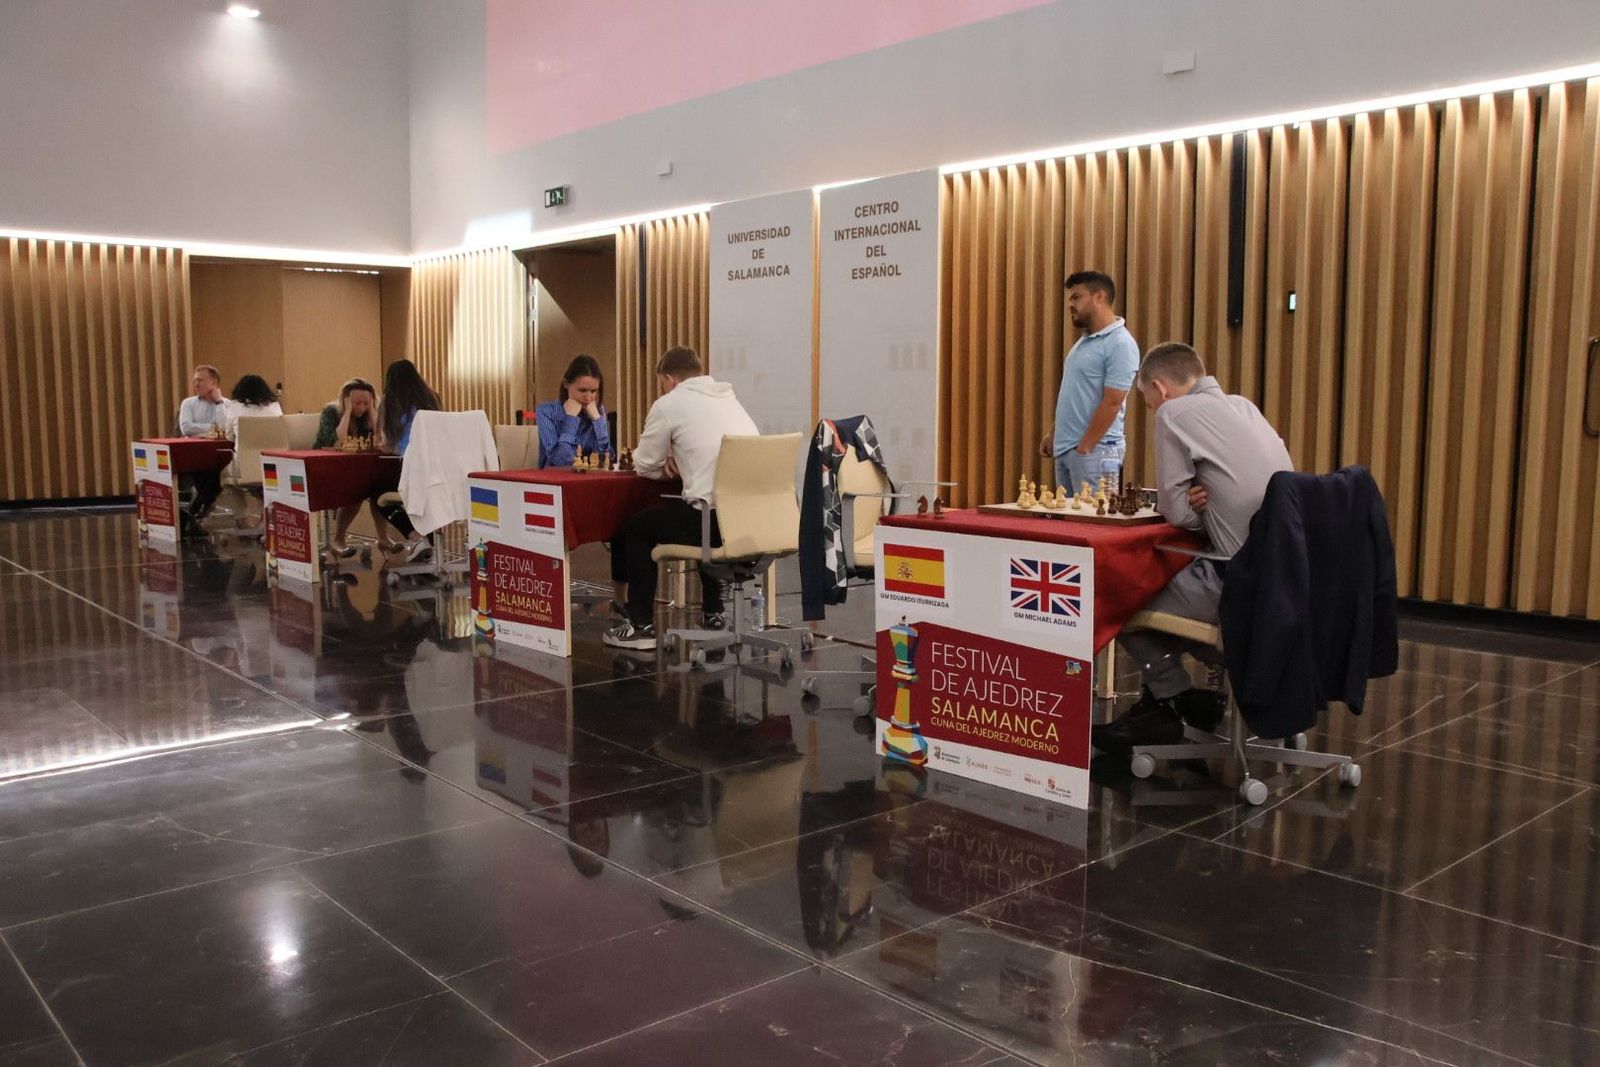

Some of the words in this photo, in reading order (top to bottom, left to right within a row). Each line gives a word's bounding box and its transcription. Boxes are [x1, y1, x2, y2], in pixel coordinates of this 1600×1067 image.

[854, 200, 899, 218] CENTRO
[727, 226, 791, 244] UNIVERSIDAD
[834, 219, 921, 242] INTERNACIONAL
[751, 248, 765, 260] DE
[866, 245, 887, 258] DEL
[727, 264, 791, 281] SALAMANCA
[851, 263, 902, 280] ESPAÑOL
[493, 553, 537, 576] FESTIVAL
[494, 572, 508, 590] DE
[509, 575, 553, 598] AJEDREZ
[495, 590, 552, 615] SALAMANCA
[880, 592, 890, 600] GM
[890, 594, 916, 604] EDUARDO
[1013, 612, 1024, 620] GM
[1024, 613, 1052, 624] MICHAEL
[1052, 617, 1077, 628] ADAMS
[931, 641, 1027, 681] FESTIVAL
[931, 668, 960, 695] DE
[963, 677, 1064, 718] AJEDREZ
[931, 696, 1059, 743] SALAMANCA
[930, 716, 955, 731] CUNA
[955, 722, 972, 735] DEL
[972, 727, 1010, 745] AJEDREZ
[1011, 736, 1060, 756] MODERNO
